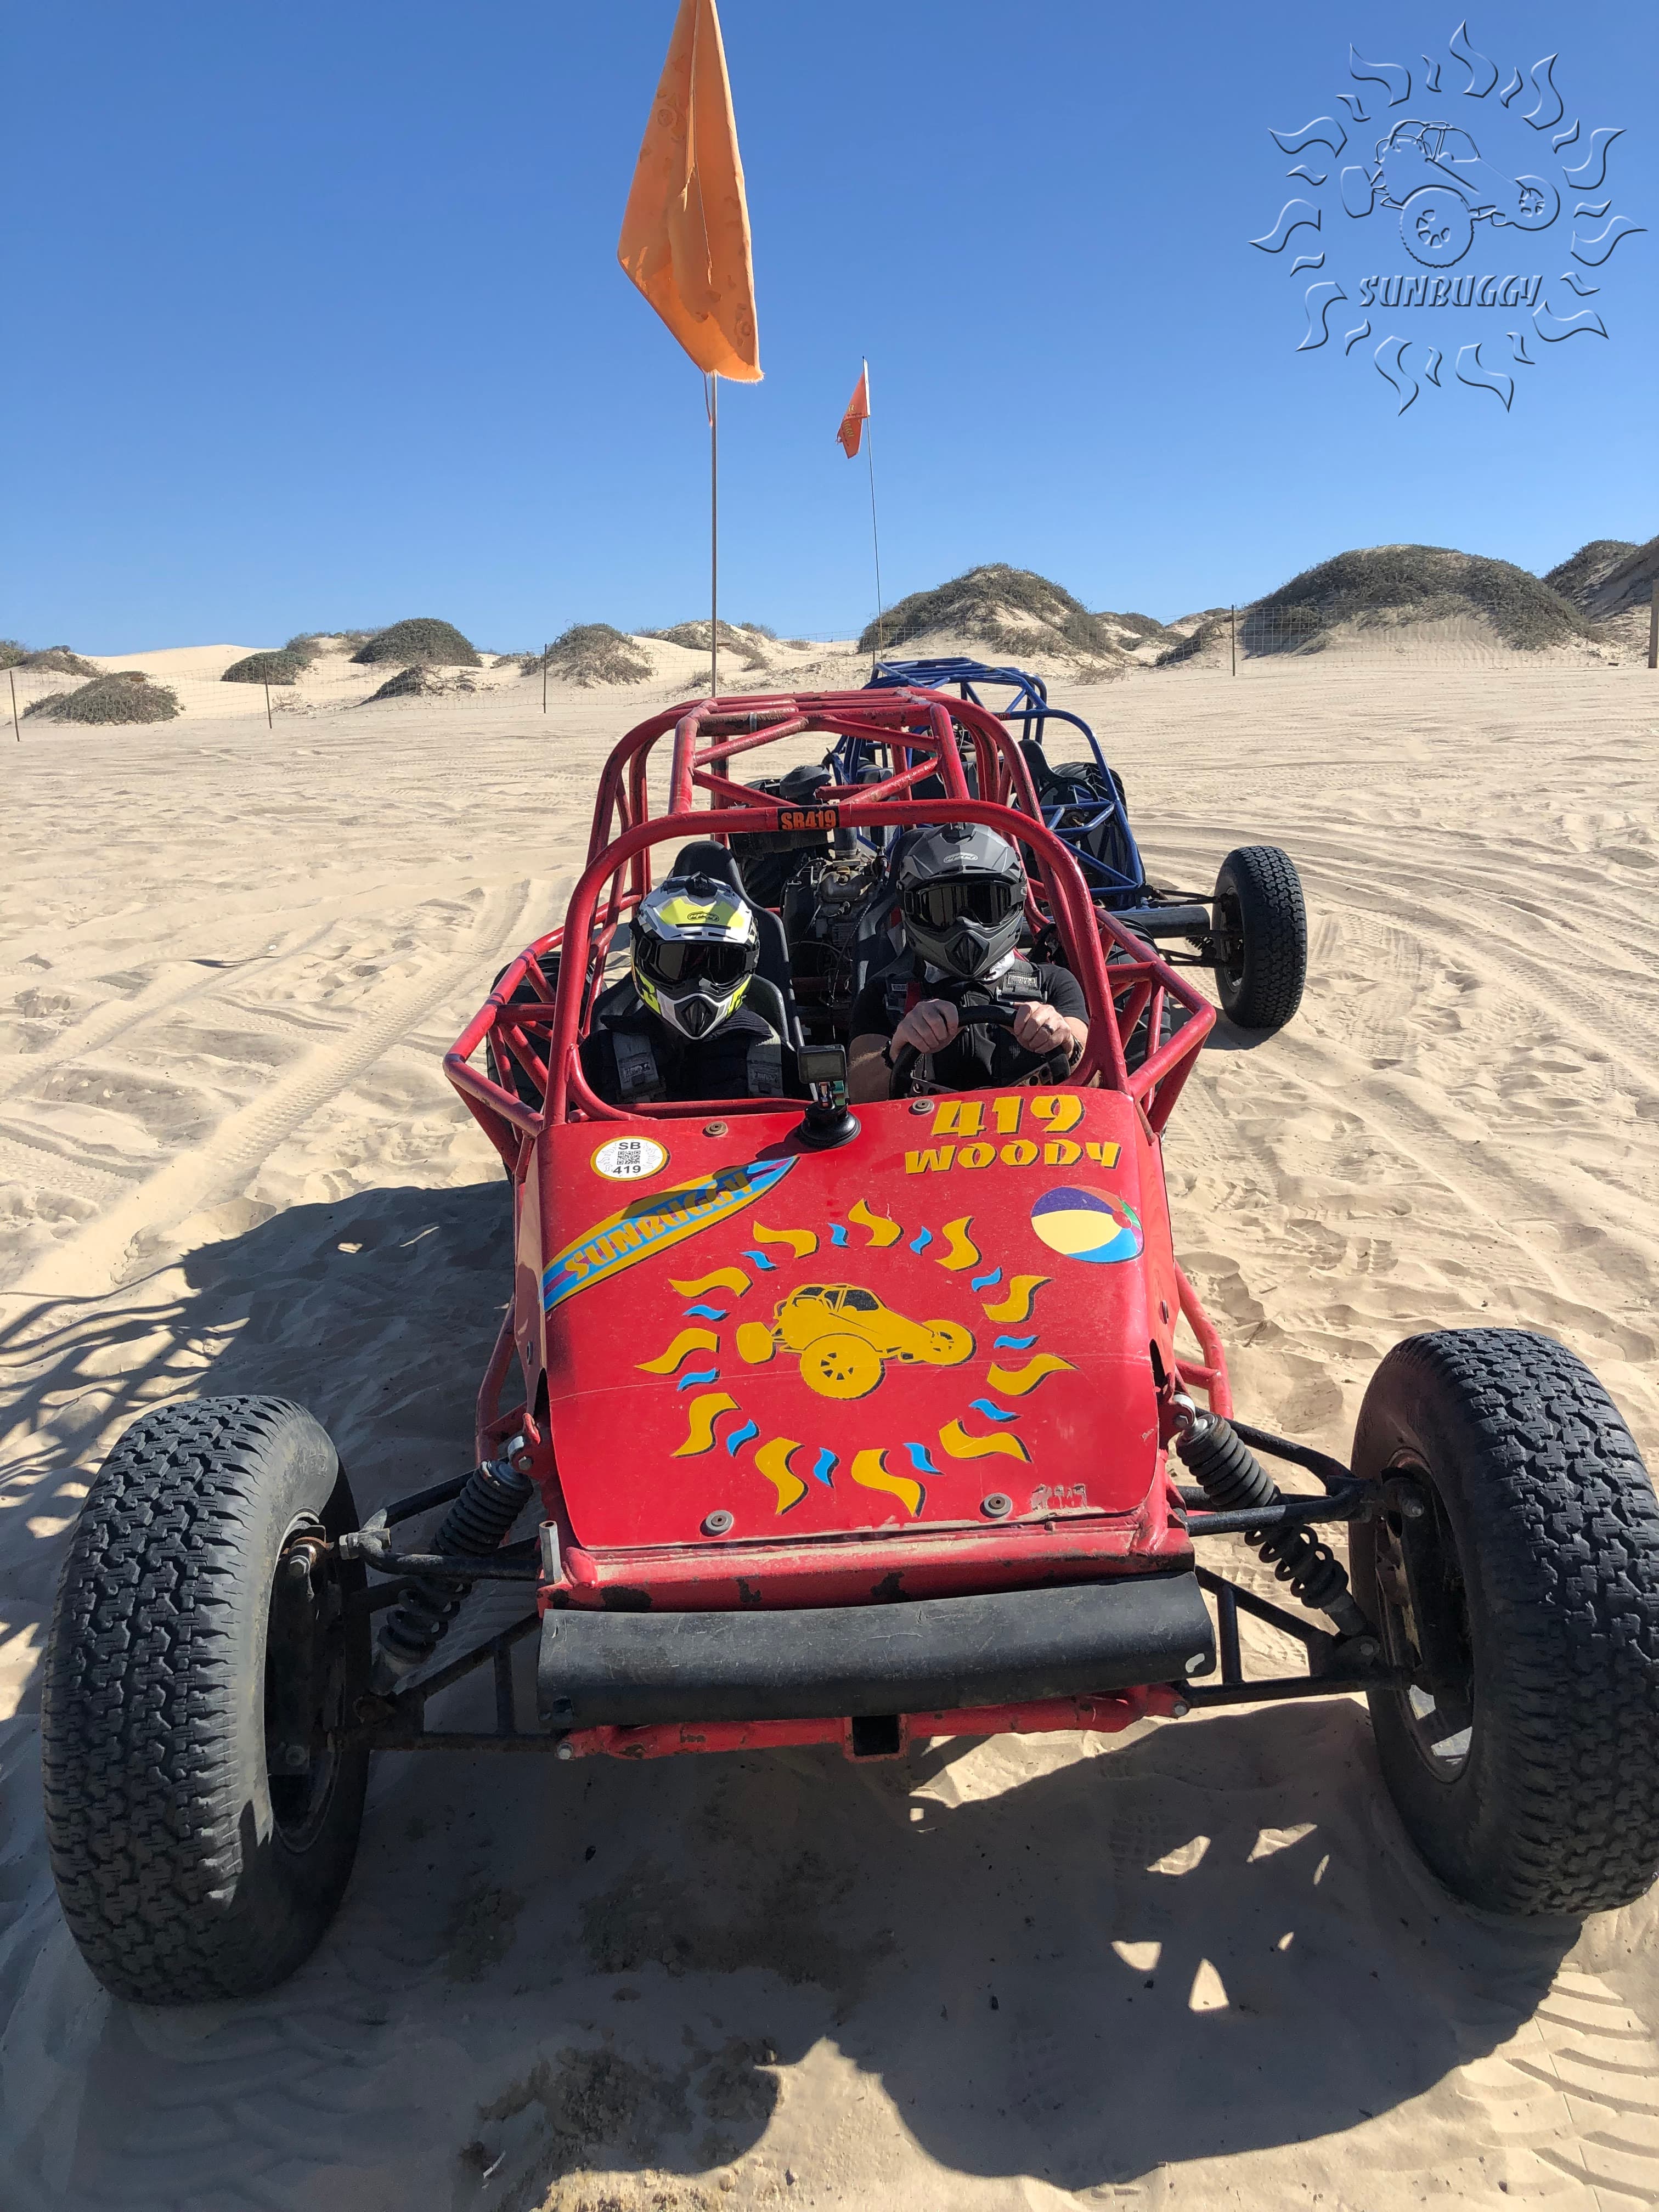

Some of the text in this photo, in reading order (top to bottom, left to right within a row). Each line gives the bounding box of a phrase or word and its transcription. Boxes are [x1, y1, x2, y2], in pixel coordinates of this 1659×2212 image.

[781, 810, 837, 830] SB419
[931, 1094, 1085, 1137] 419
[618, 1142, 641, 1150] SB
[905, 1139, 1122, 1174] WOODY
[612, 1165, 641, 1174] 419
[565, 1172, 753, 1280] SUNBUGGY
